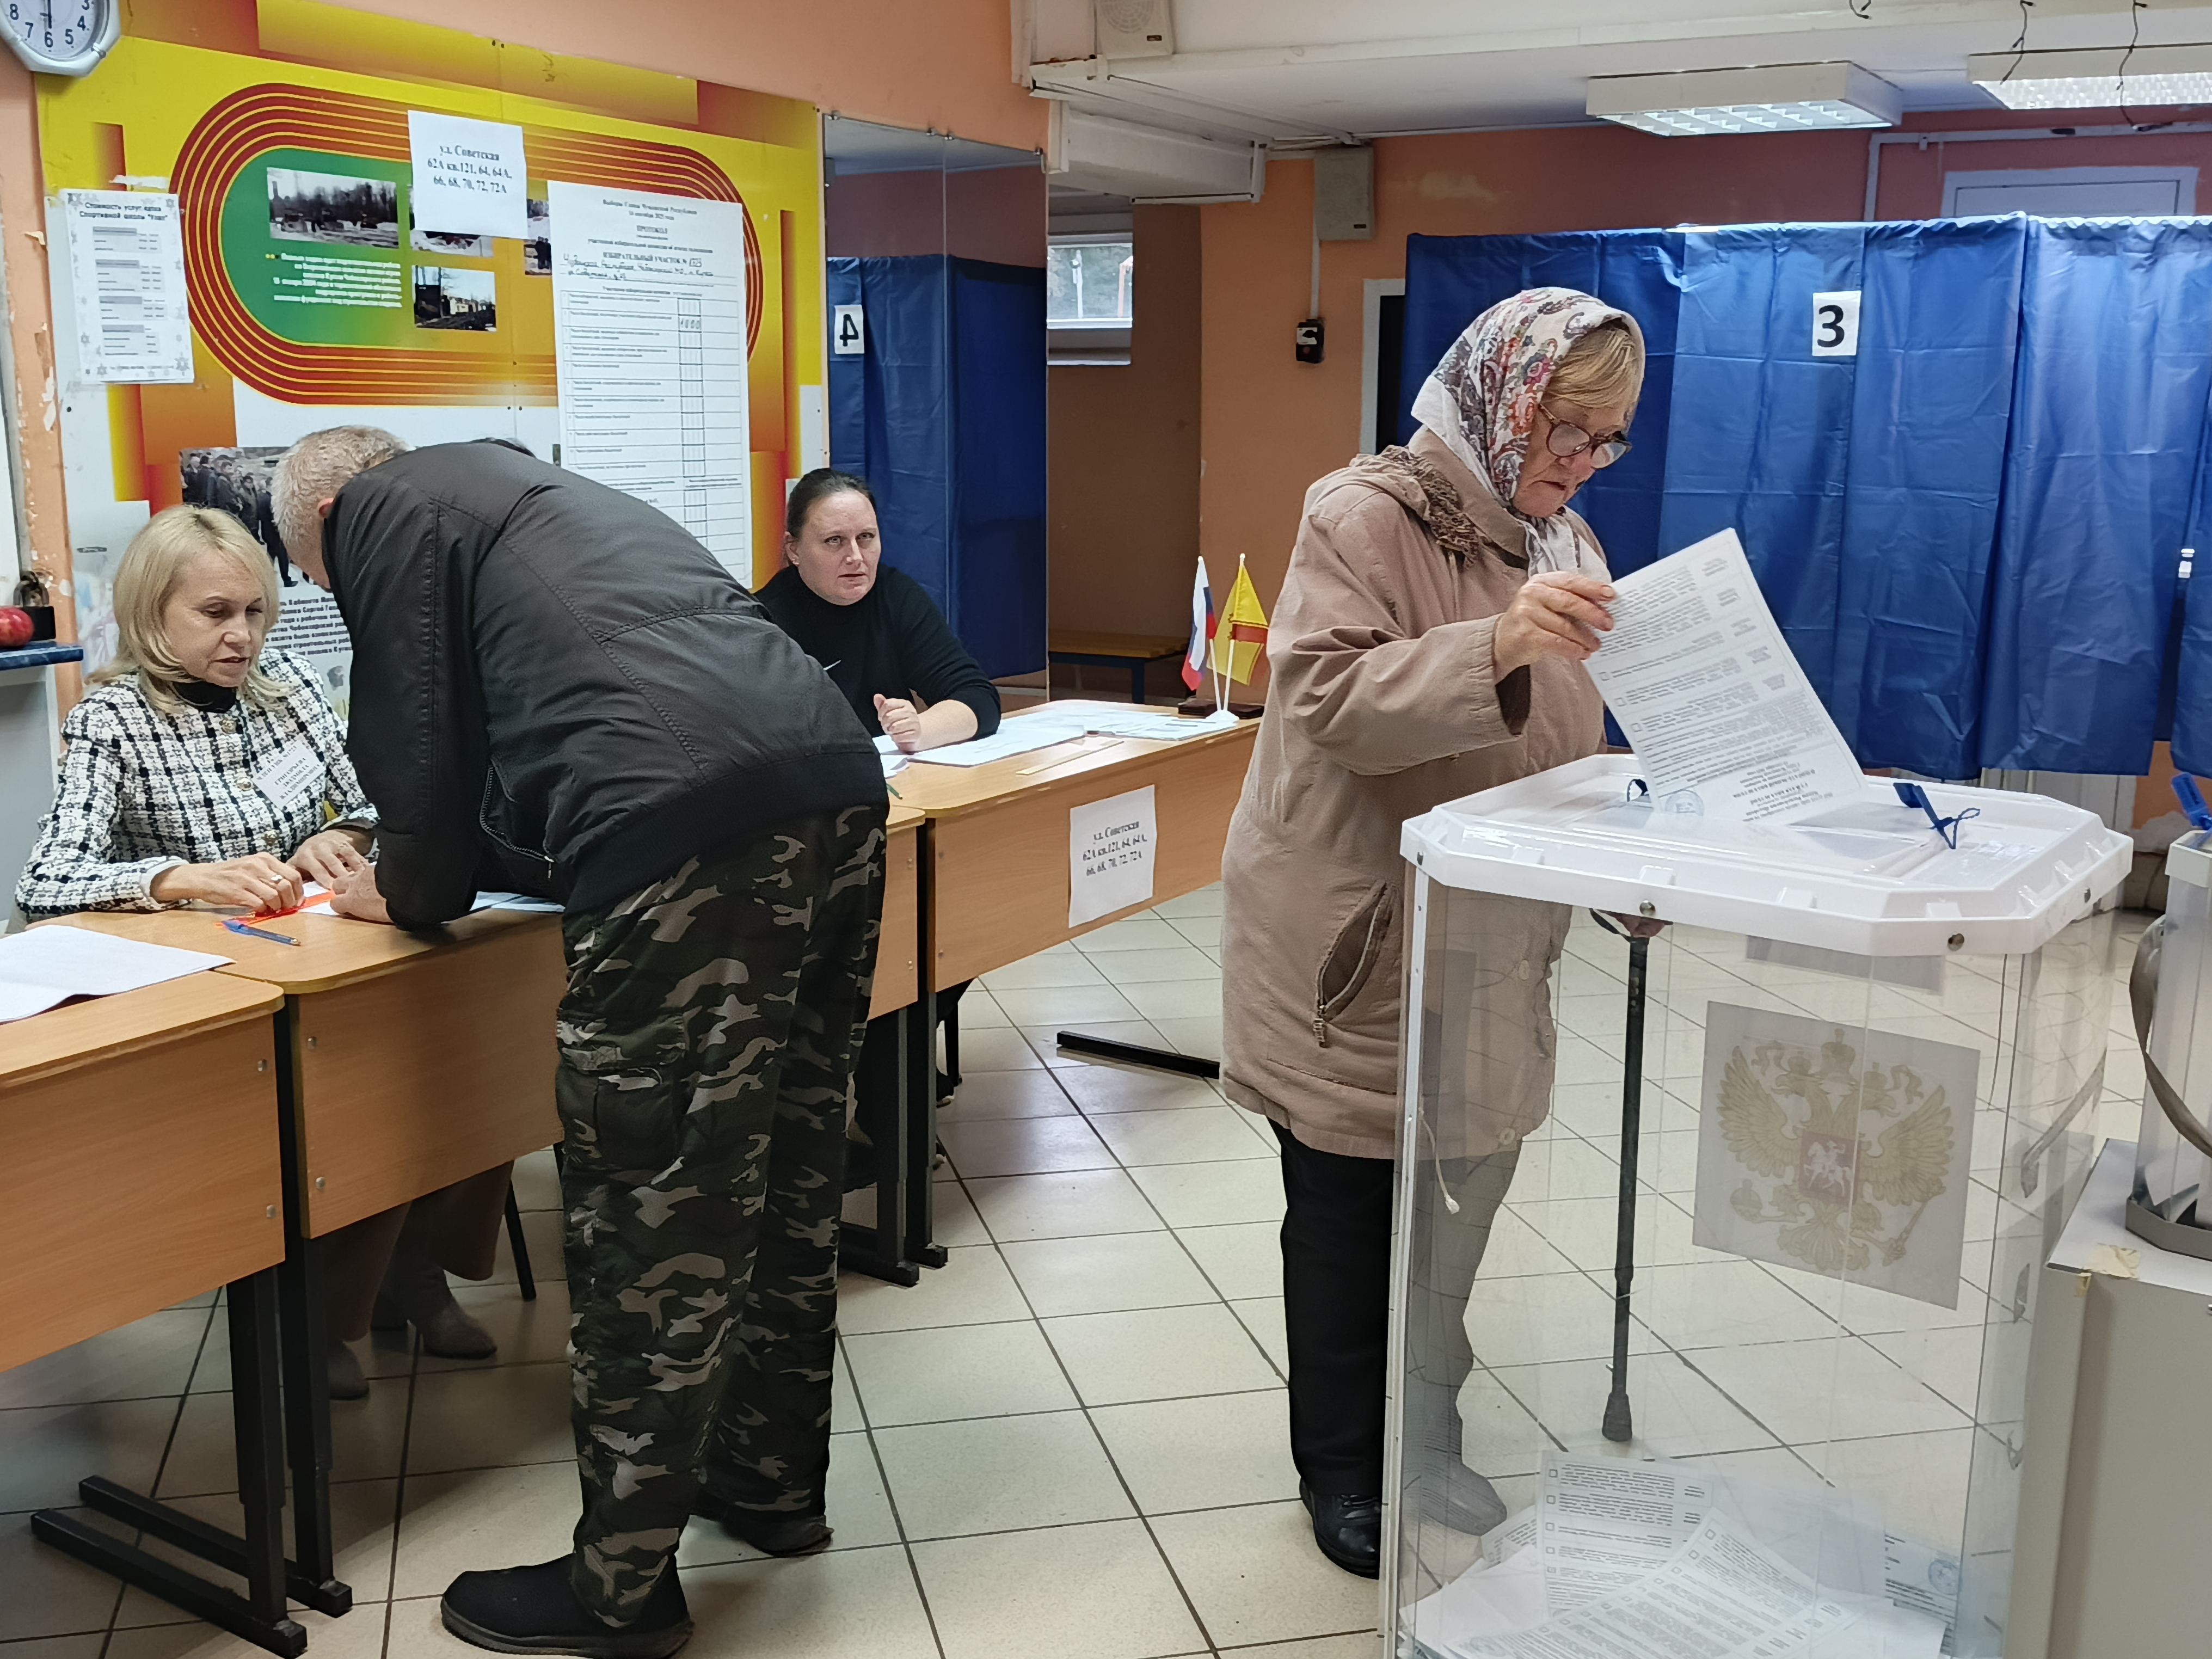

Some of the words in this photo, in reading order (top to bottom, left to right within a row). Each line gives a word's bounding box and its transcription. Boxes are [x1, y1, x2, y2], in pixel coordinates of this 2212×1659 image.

[10, 3, 19, 20] 8
[25, 22, 34, 38] 7
[77, 15, 86, 31] 4
[44, 31, 53, 48] 6
[65, 28, 74, 45] 5
[454, 145, 500, 161] Советская
[1817, 305, 1845, 348] 3
